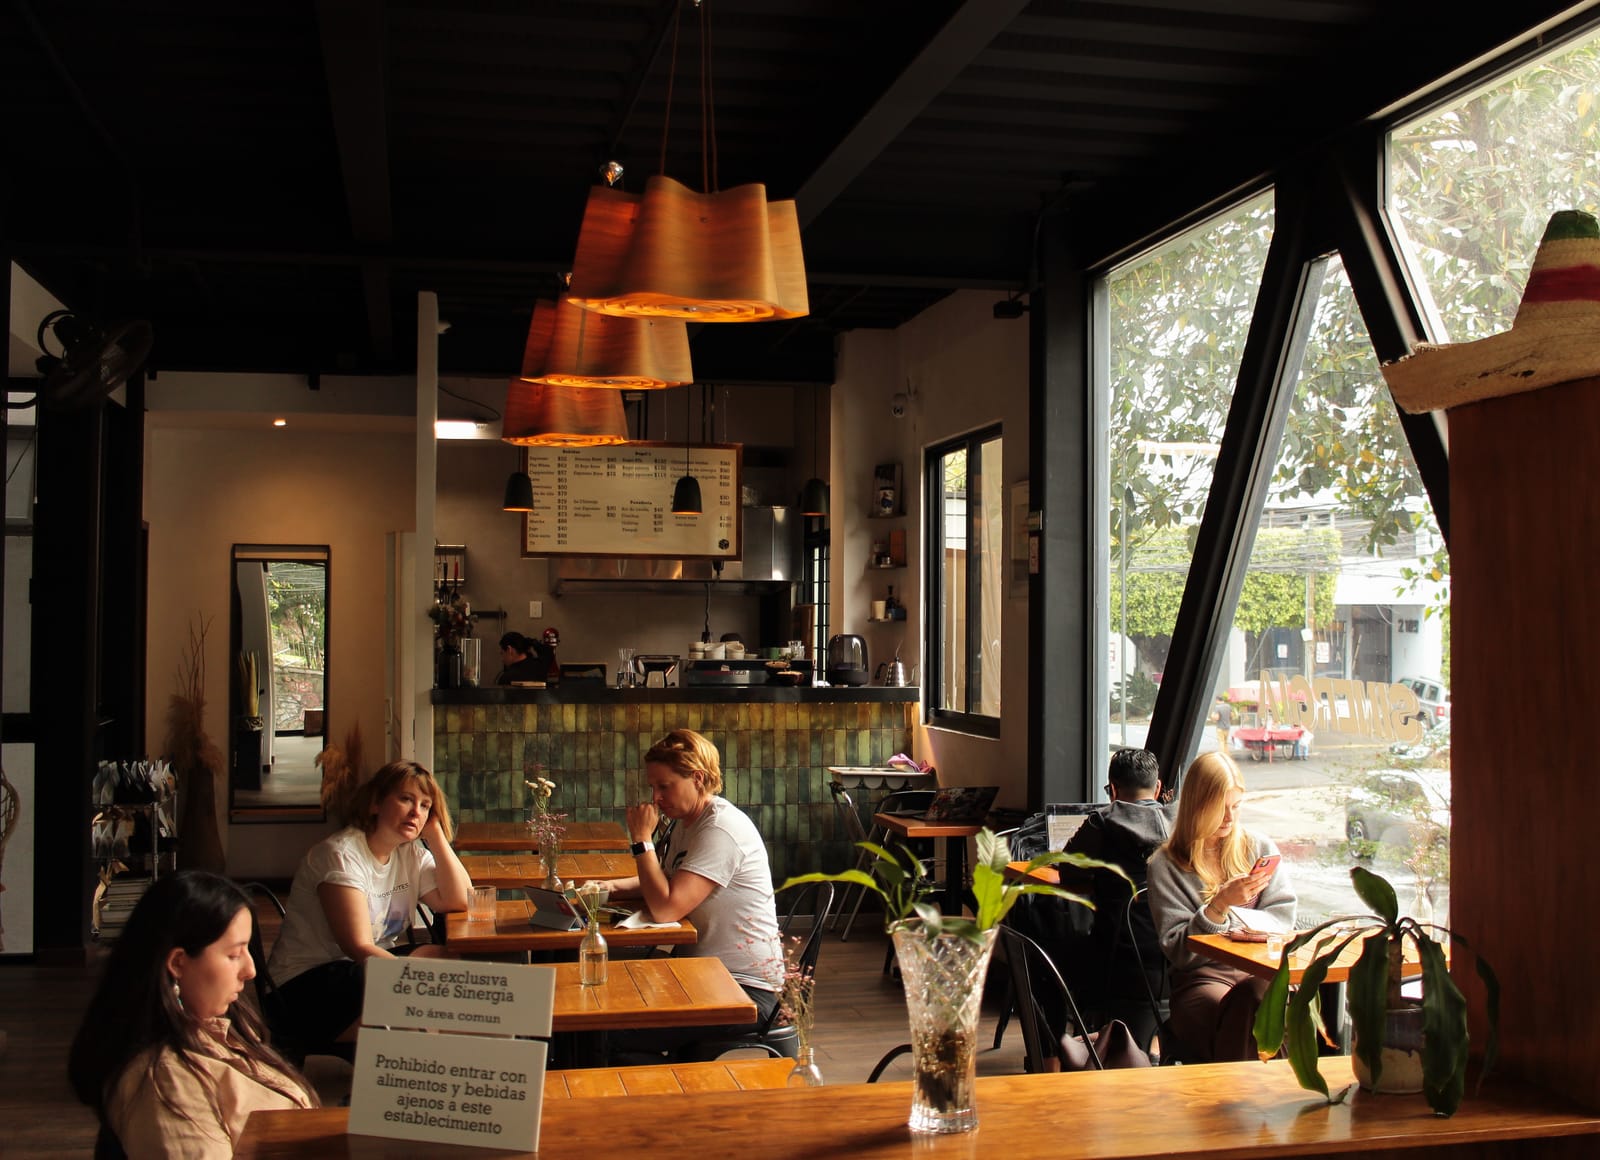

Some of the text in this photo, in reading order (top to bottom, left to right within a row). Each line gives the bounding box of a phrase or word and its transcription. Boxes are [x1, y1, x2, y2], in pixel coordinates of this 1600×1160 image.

[400, 963, 508, 987] Área exclusiva
[393, 981, 514, 1005] de Café Sinergia
[406, 1006, 501, 1024] No área comun
[376, 1054, 527, 1084] Prohibido entrar con
[377, 1074, 526, 1101] alimentos y bebidas
[397, 1094, 492, 1115] ajenos a este
[384, 1109, 503, 1134] establecimiento
